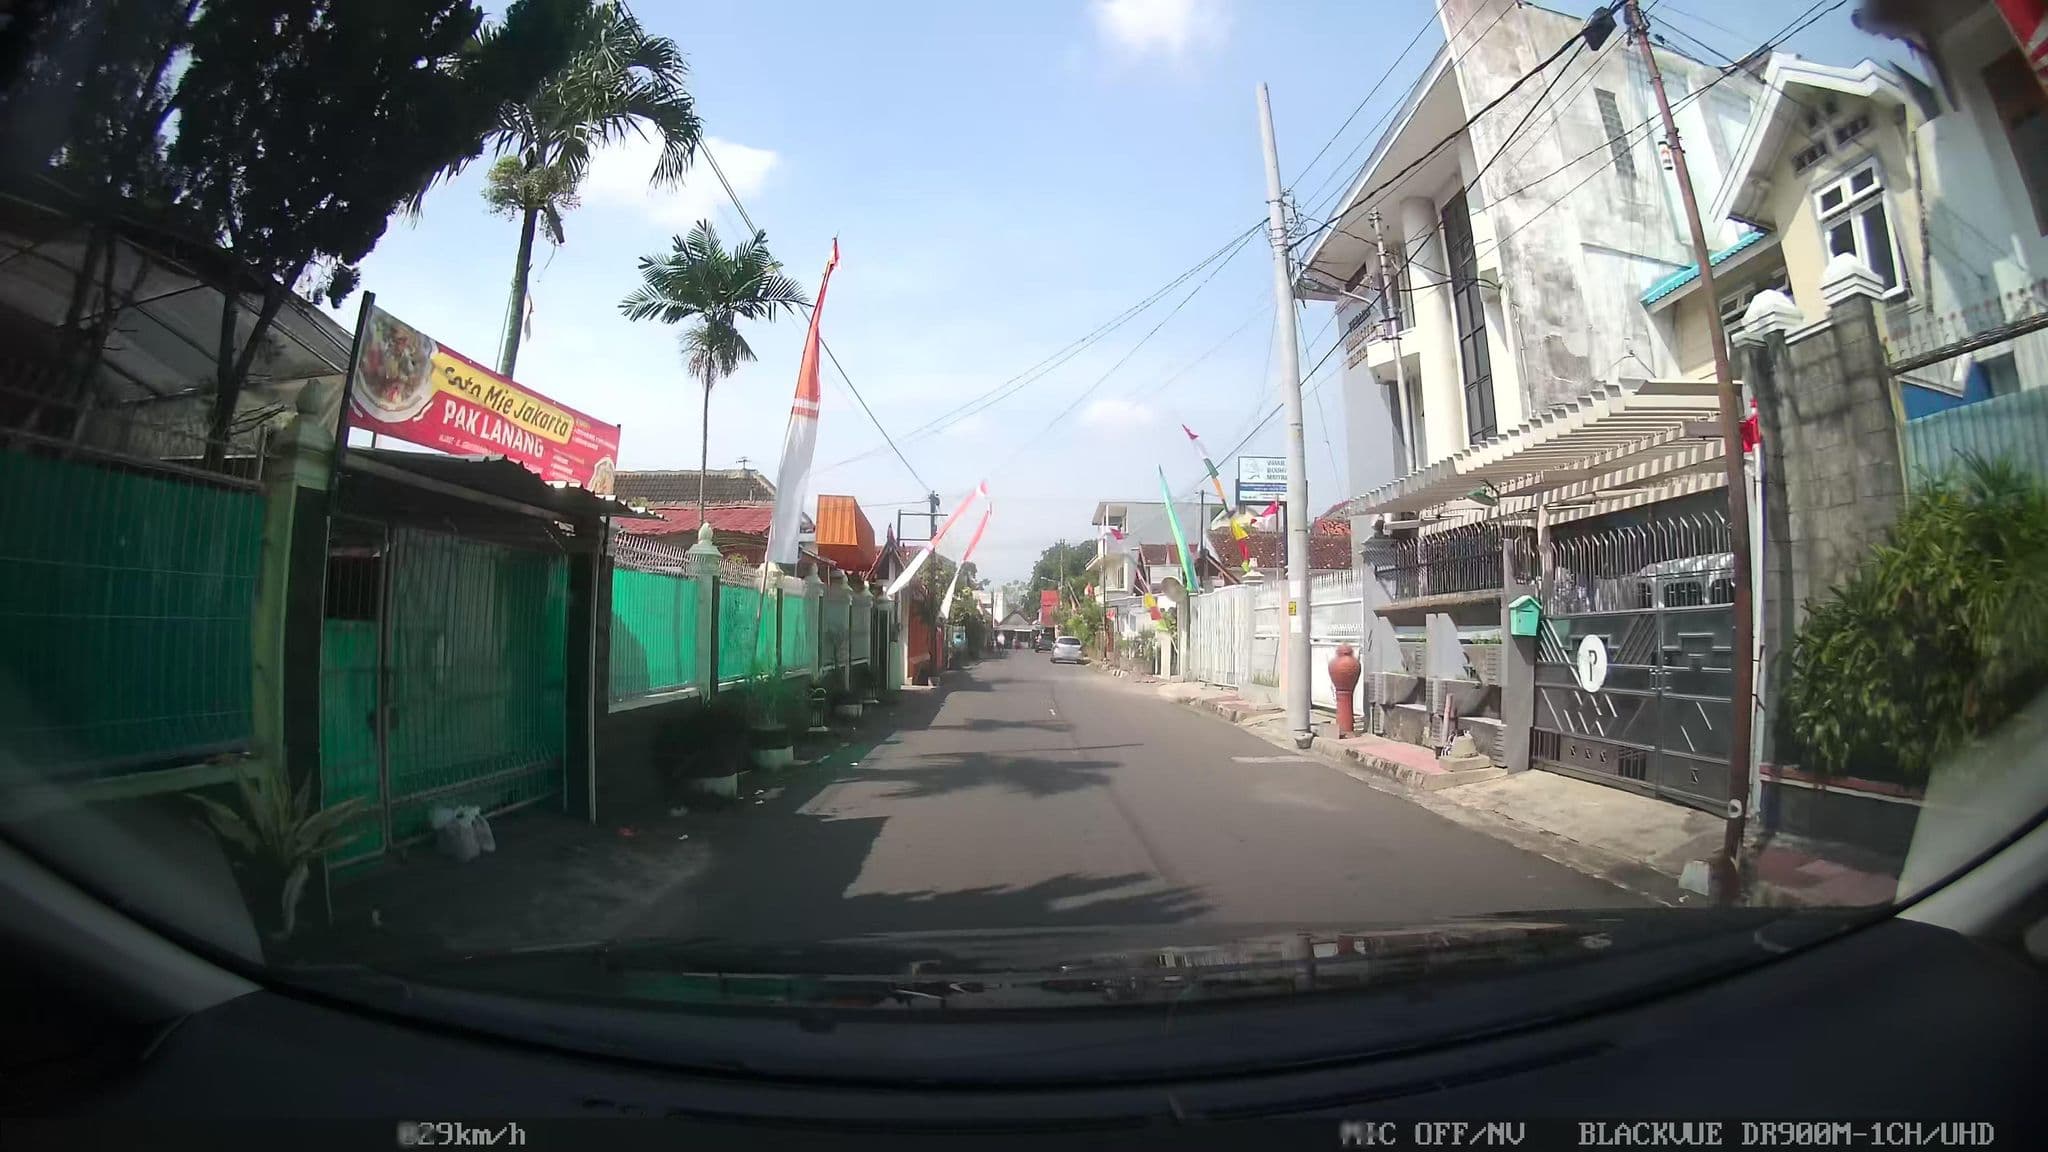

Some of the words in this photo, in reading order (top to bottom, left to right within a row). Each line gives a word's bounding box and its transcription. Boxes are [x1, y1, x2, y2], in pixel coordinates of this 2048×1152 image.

[443, 399, 481, 436] PAK
[480, 415, 545, 458] LANANG
[484, 386, 515, 415] Mie
[514, 400, 570, 438] Jakarta
